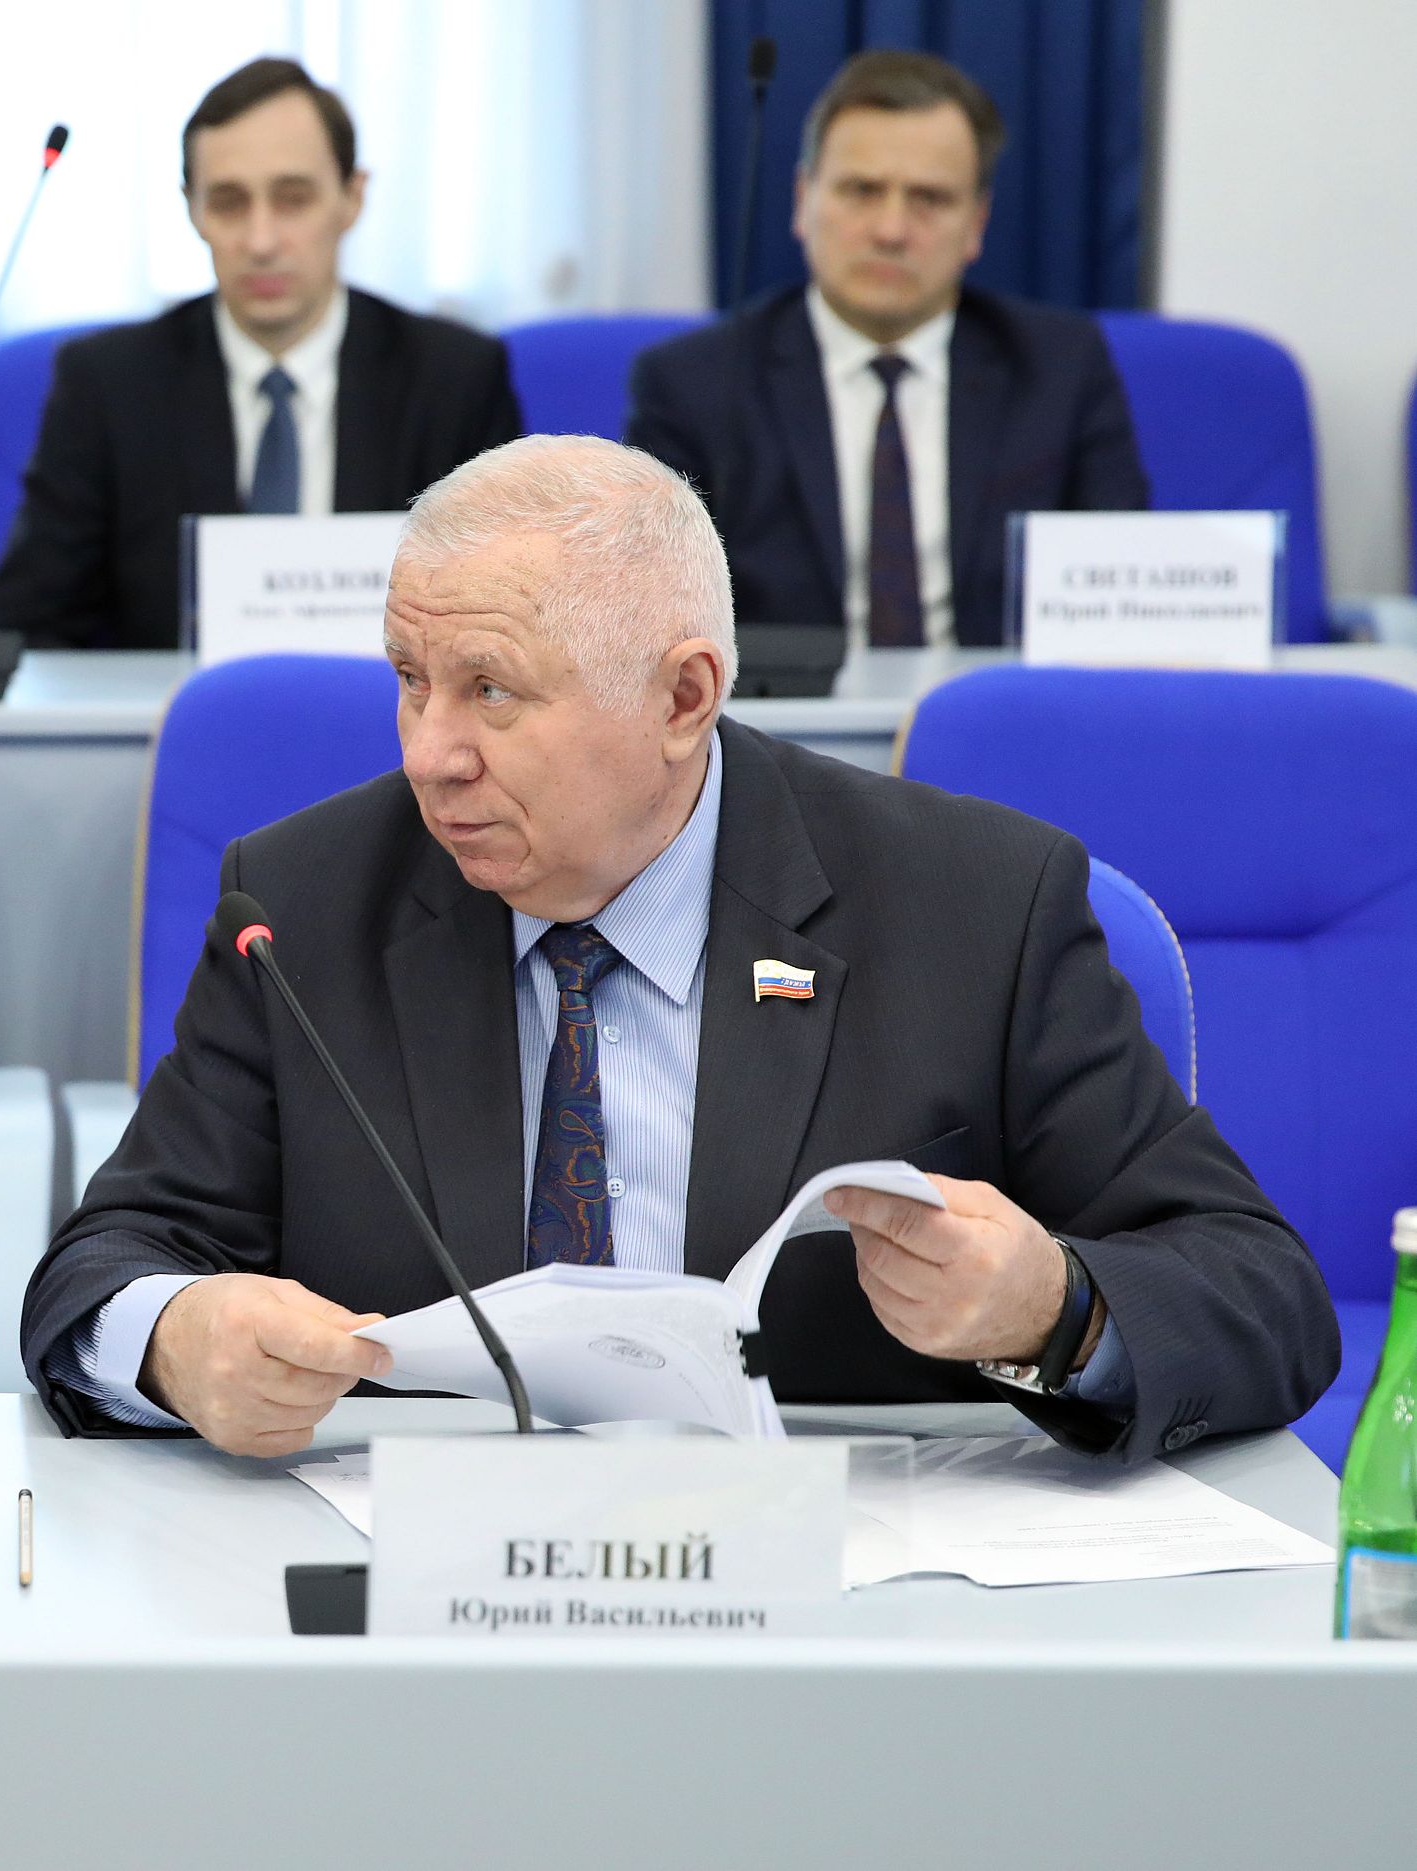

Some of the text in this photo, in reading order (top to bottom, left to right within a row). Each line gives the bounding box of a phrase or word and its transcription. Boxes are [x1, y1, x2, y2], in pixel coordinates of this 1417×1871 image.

[504, 1532, 715, 1580] БЕЛЫЙ
[448, 1597, 767, 1632] Юрий Васильевич
